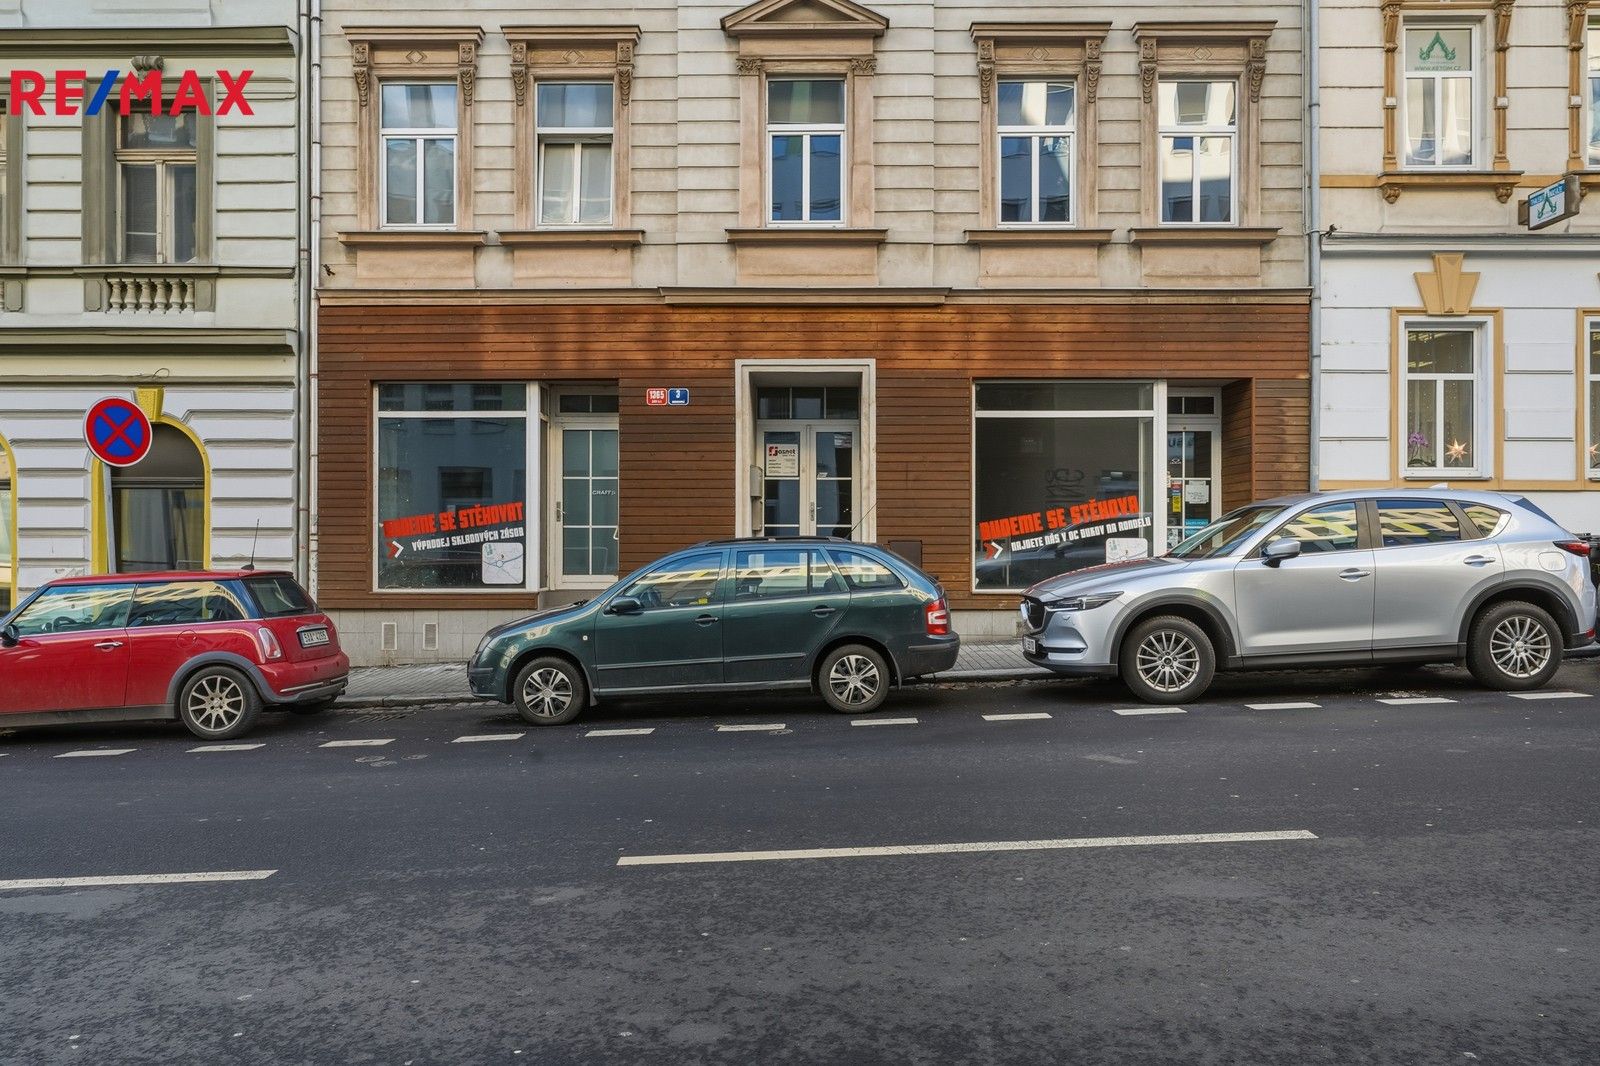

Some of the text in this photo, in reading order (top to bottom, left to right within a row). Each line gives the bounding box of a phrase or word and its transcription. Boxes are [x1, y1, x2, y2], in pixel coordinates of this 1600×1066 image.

[649, 390, 665, 399] 1365
[675, 390, 681, 399] 3
[438, 510, 457, 532] SE
[457, 501, 524, 530] STĚHOVAT
[1045, 507, 1067, 530] SE
[411, 526, 525, 552] VÝPRODEJ SKLADOVÝCH ZÁSOB
[1011, 536, 1044, 552] NAJDETE
[1044, 533, 1061, 546] NÁS
[1061, 531, 1067, 542] V
[1106, 522, 1118, 534] NA
[1118, 516, 1152, 532] RONDELU
